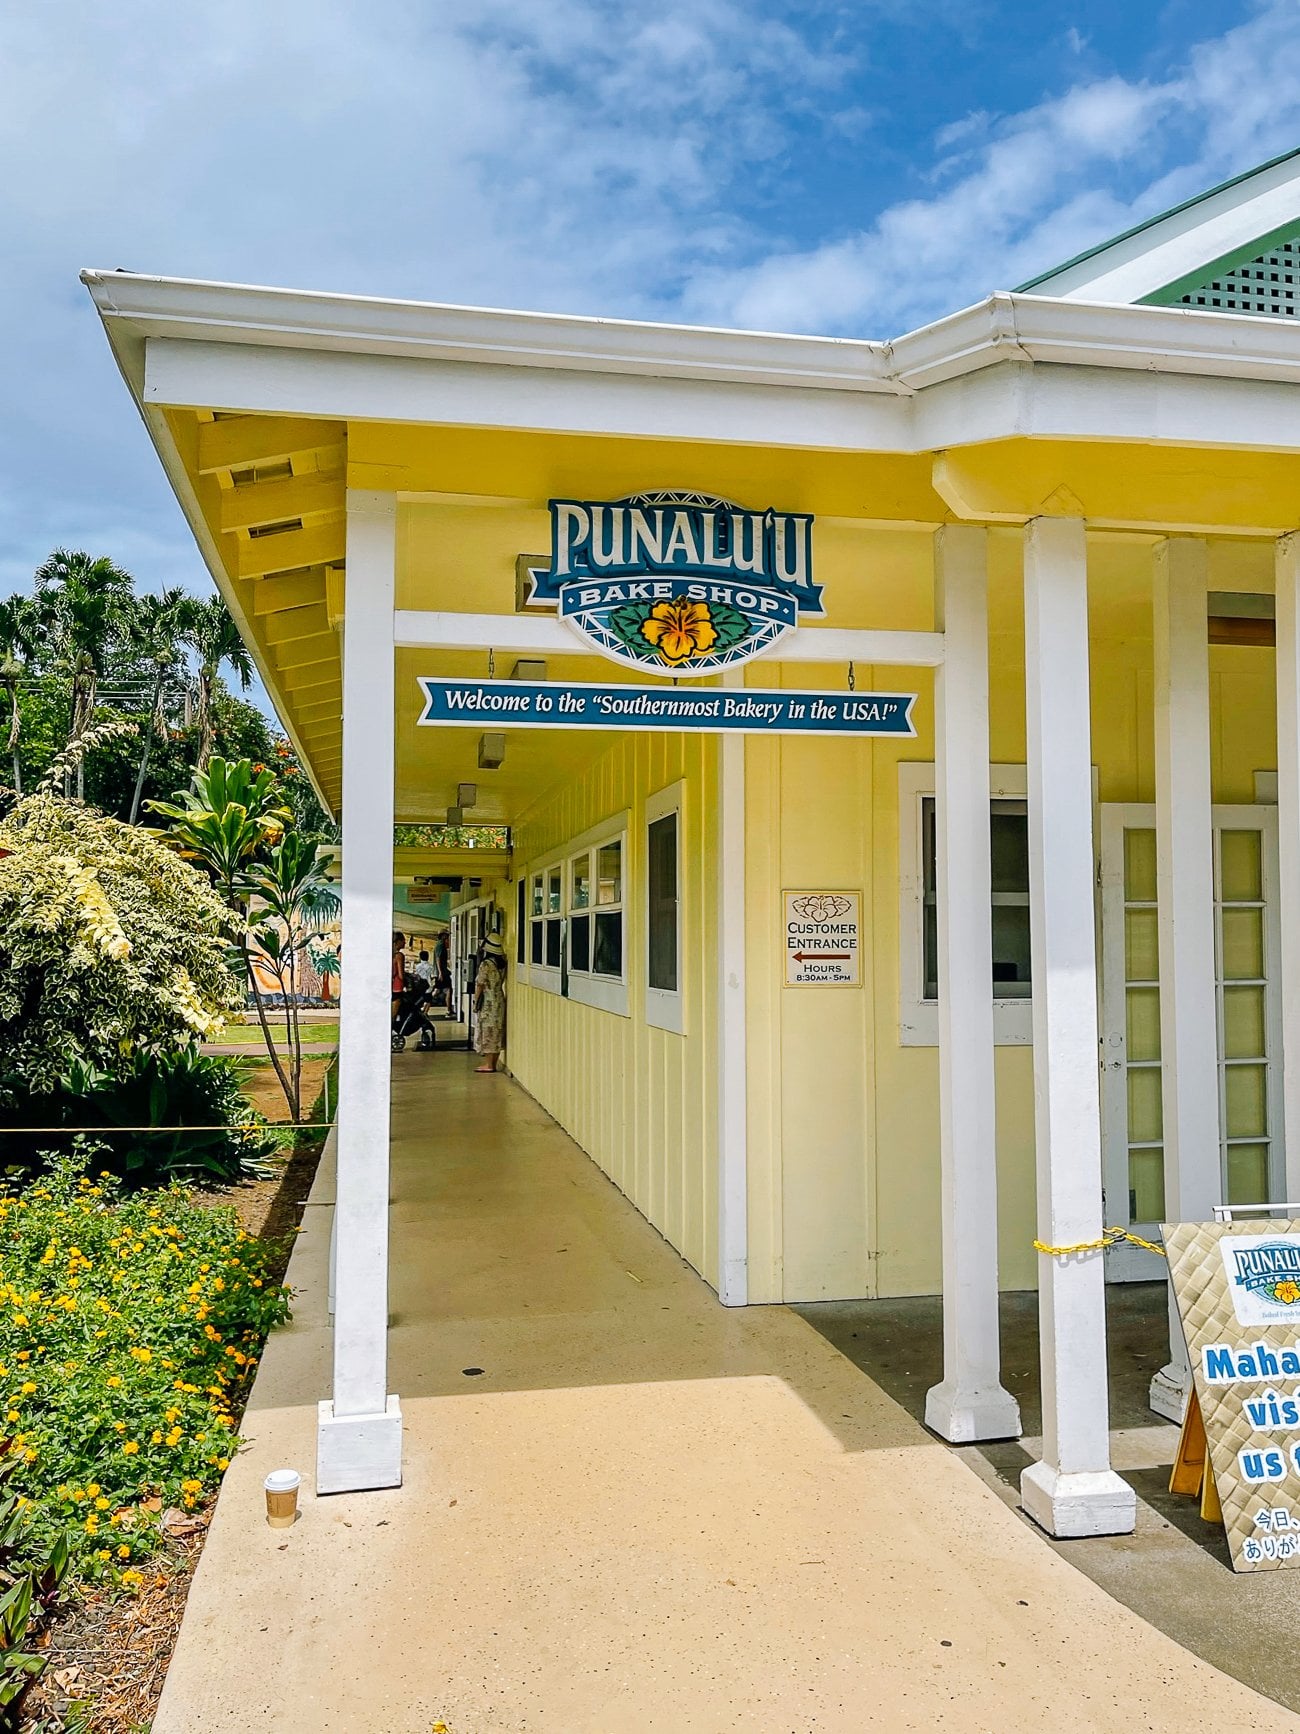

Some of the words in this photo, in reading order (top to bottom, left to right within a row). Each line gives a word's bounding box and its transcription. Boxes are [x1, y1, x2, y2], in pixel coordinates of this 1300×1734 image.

[555, 503, 808, 588] PUNALU'U
[578, 582, 673, 607] BAKE
[687, 584, 780, 614] SHOP
[445, 688, 530, 711] Welcome
[535, 694, 553, 712] to
[558, 692, 586, 713] the
[592, 694, 720, 717] “Southernmost
[723, 697, 783, 724] Bakery
[788, 700, 805, 719] in
[810, 700, 837, 720] the
[842, 702, 898, 721] USA!”
[788, 922, 857, 934] CUSTOMER
[788, 936, 857, 949] ENTRANCE
[804, 964, 842, 973] HOURS
[1250, 1275, 1281, 1287] BAKE
[1247, 1393, 1300, 1426] vis
[1243, 1452, 1283, 1479] us
